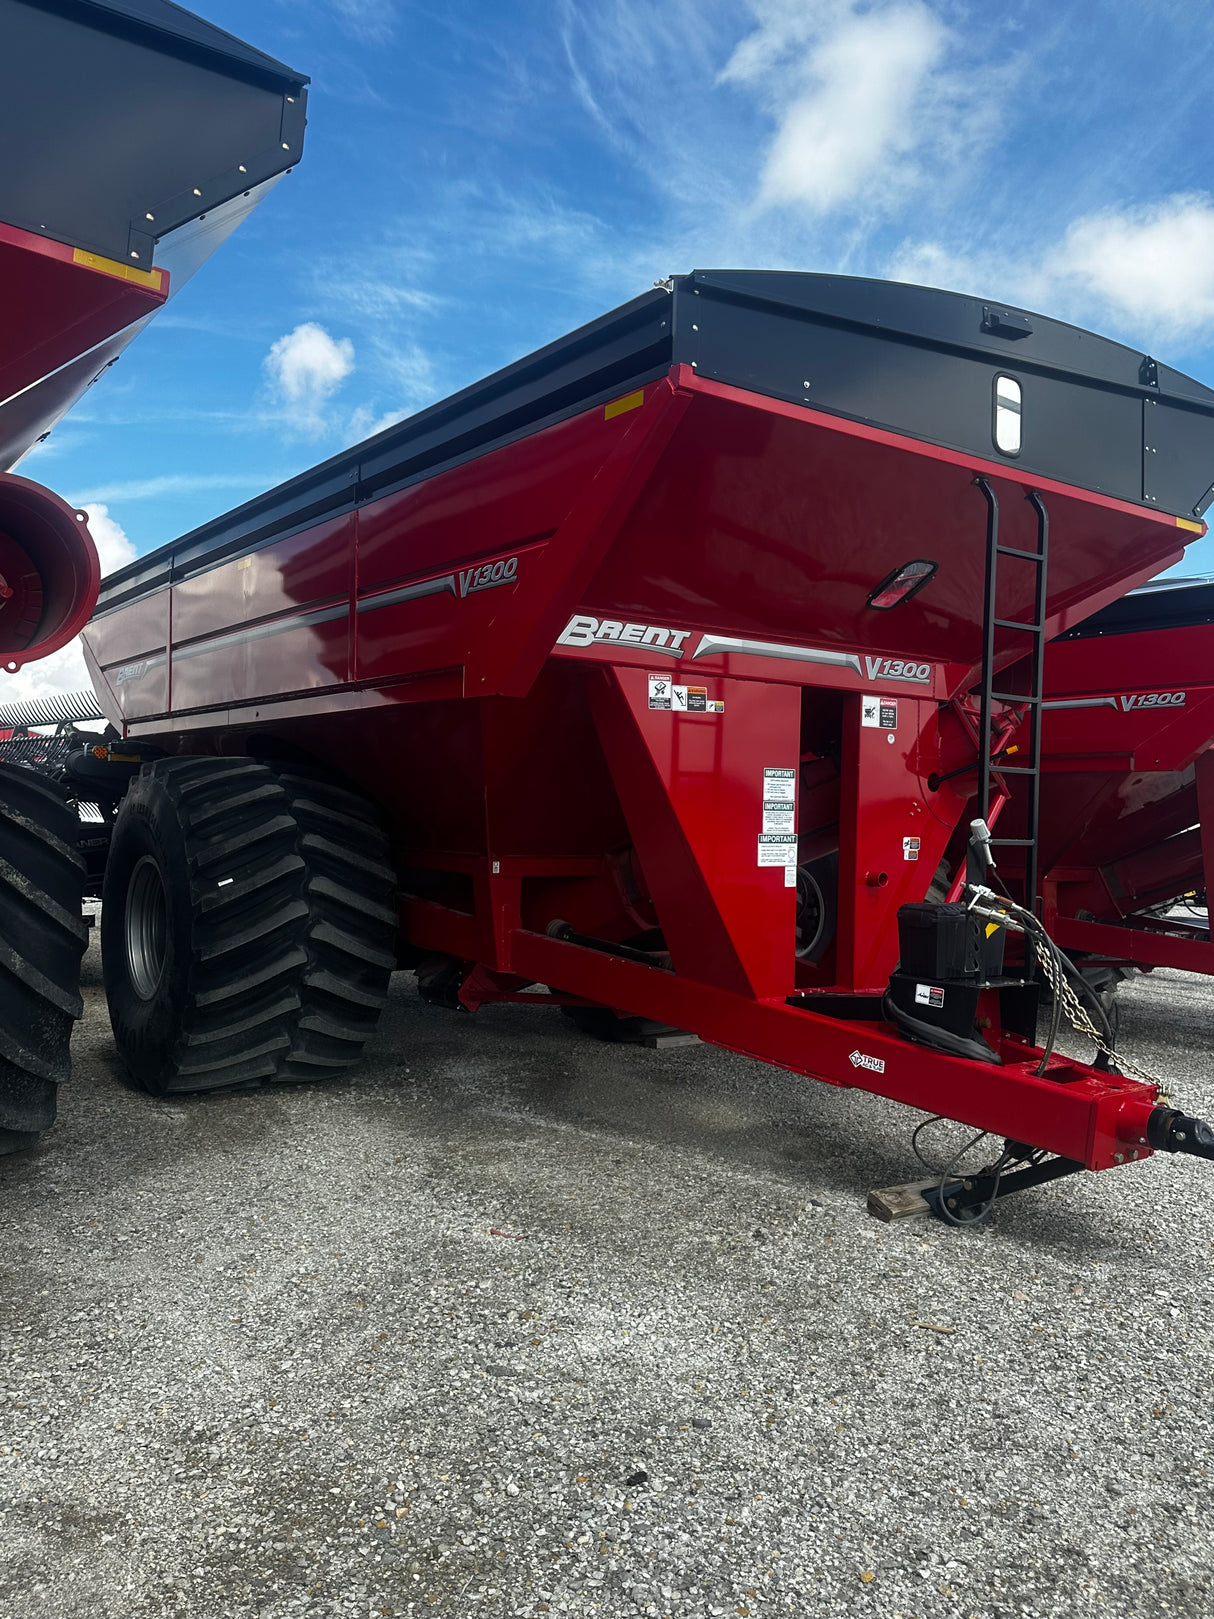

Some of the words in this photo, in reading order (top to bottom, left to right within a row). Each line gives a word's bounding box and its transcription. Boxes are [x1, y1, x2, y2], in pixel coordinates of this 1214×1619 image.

[459, 557, 518, 599] V1300
[556, 614, 691, 651] BRENT
[865, 656, 931, 682] V1300
[1120, 692, 1186, 713] V1300
[765, 769, 794, 778] IMPORTANT
[765, 802, 793, 811] IMPORTANT
[760, 835, 796, 843] IMPORTANT
[863, 1055, 884, 1069] TRUE
